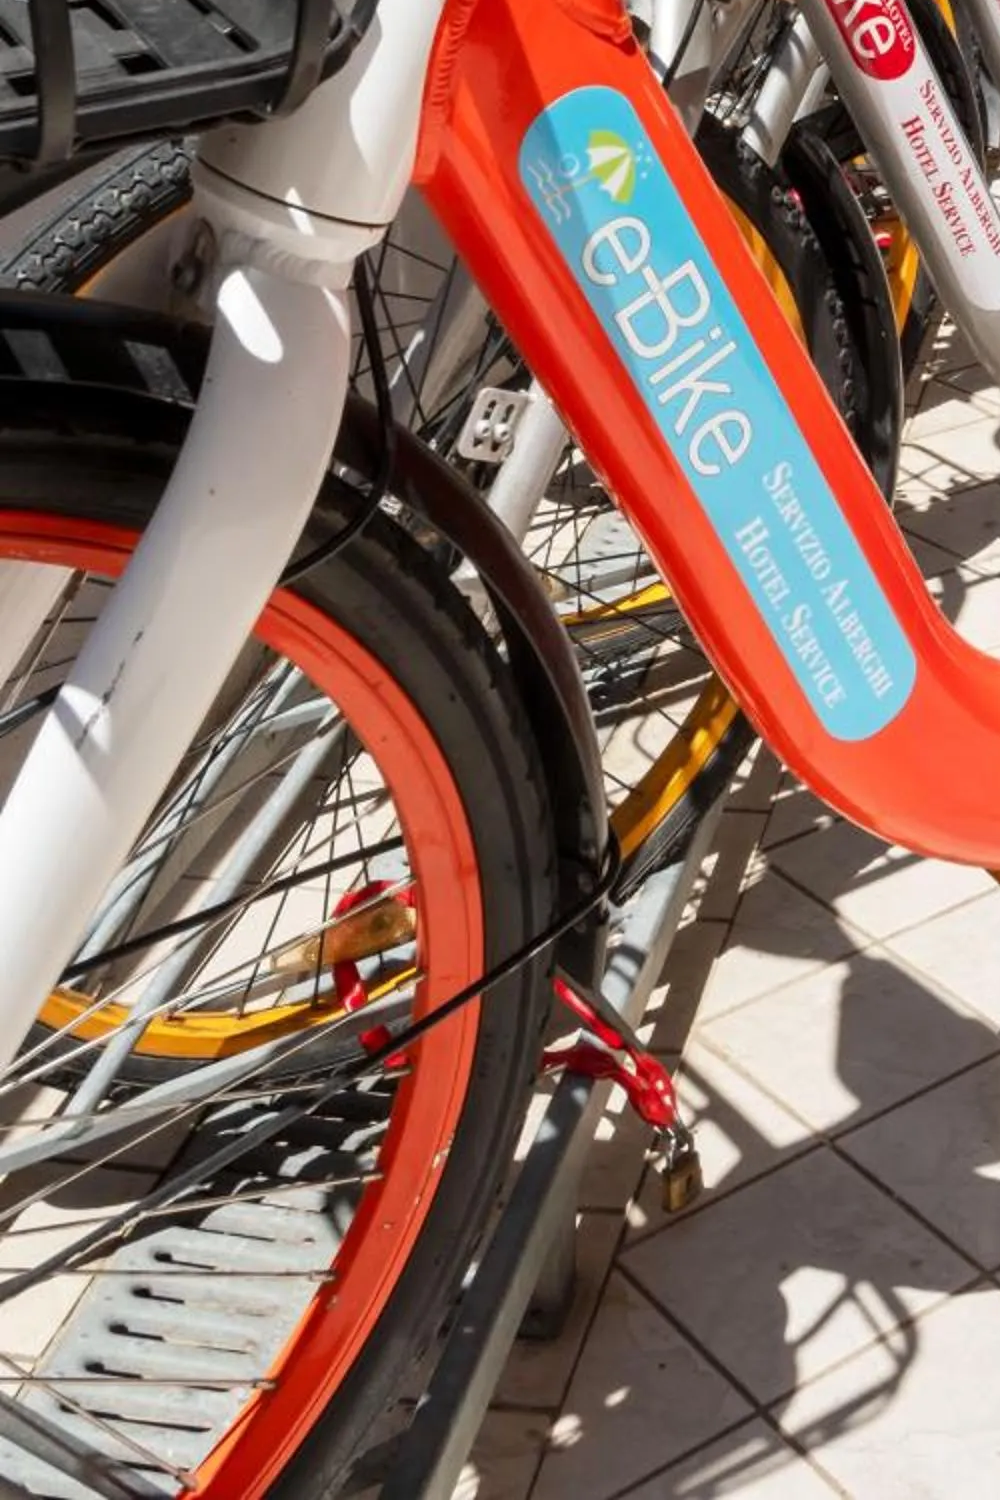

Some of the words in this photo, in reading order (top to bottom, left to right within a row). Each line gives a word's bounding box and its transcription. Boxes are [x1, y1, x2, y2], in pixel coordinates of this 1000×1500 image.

[901, 115, 940, 183] HOTEL
[932, 180, 977, 258] SERVICE
[919, 78, 964, 166] SERVIZIO
[735, 516, 791, 613] HOTEL
[781, 603, 847, 710] SERVICE
[763, 460, 832, 583] SERVIZIO
[820, 575, 895, 701] ALBERGHI
